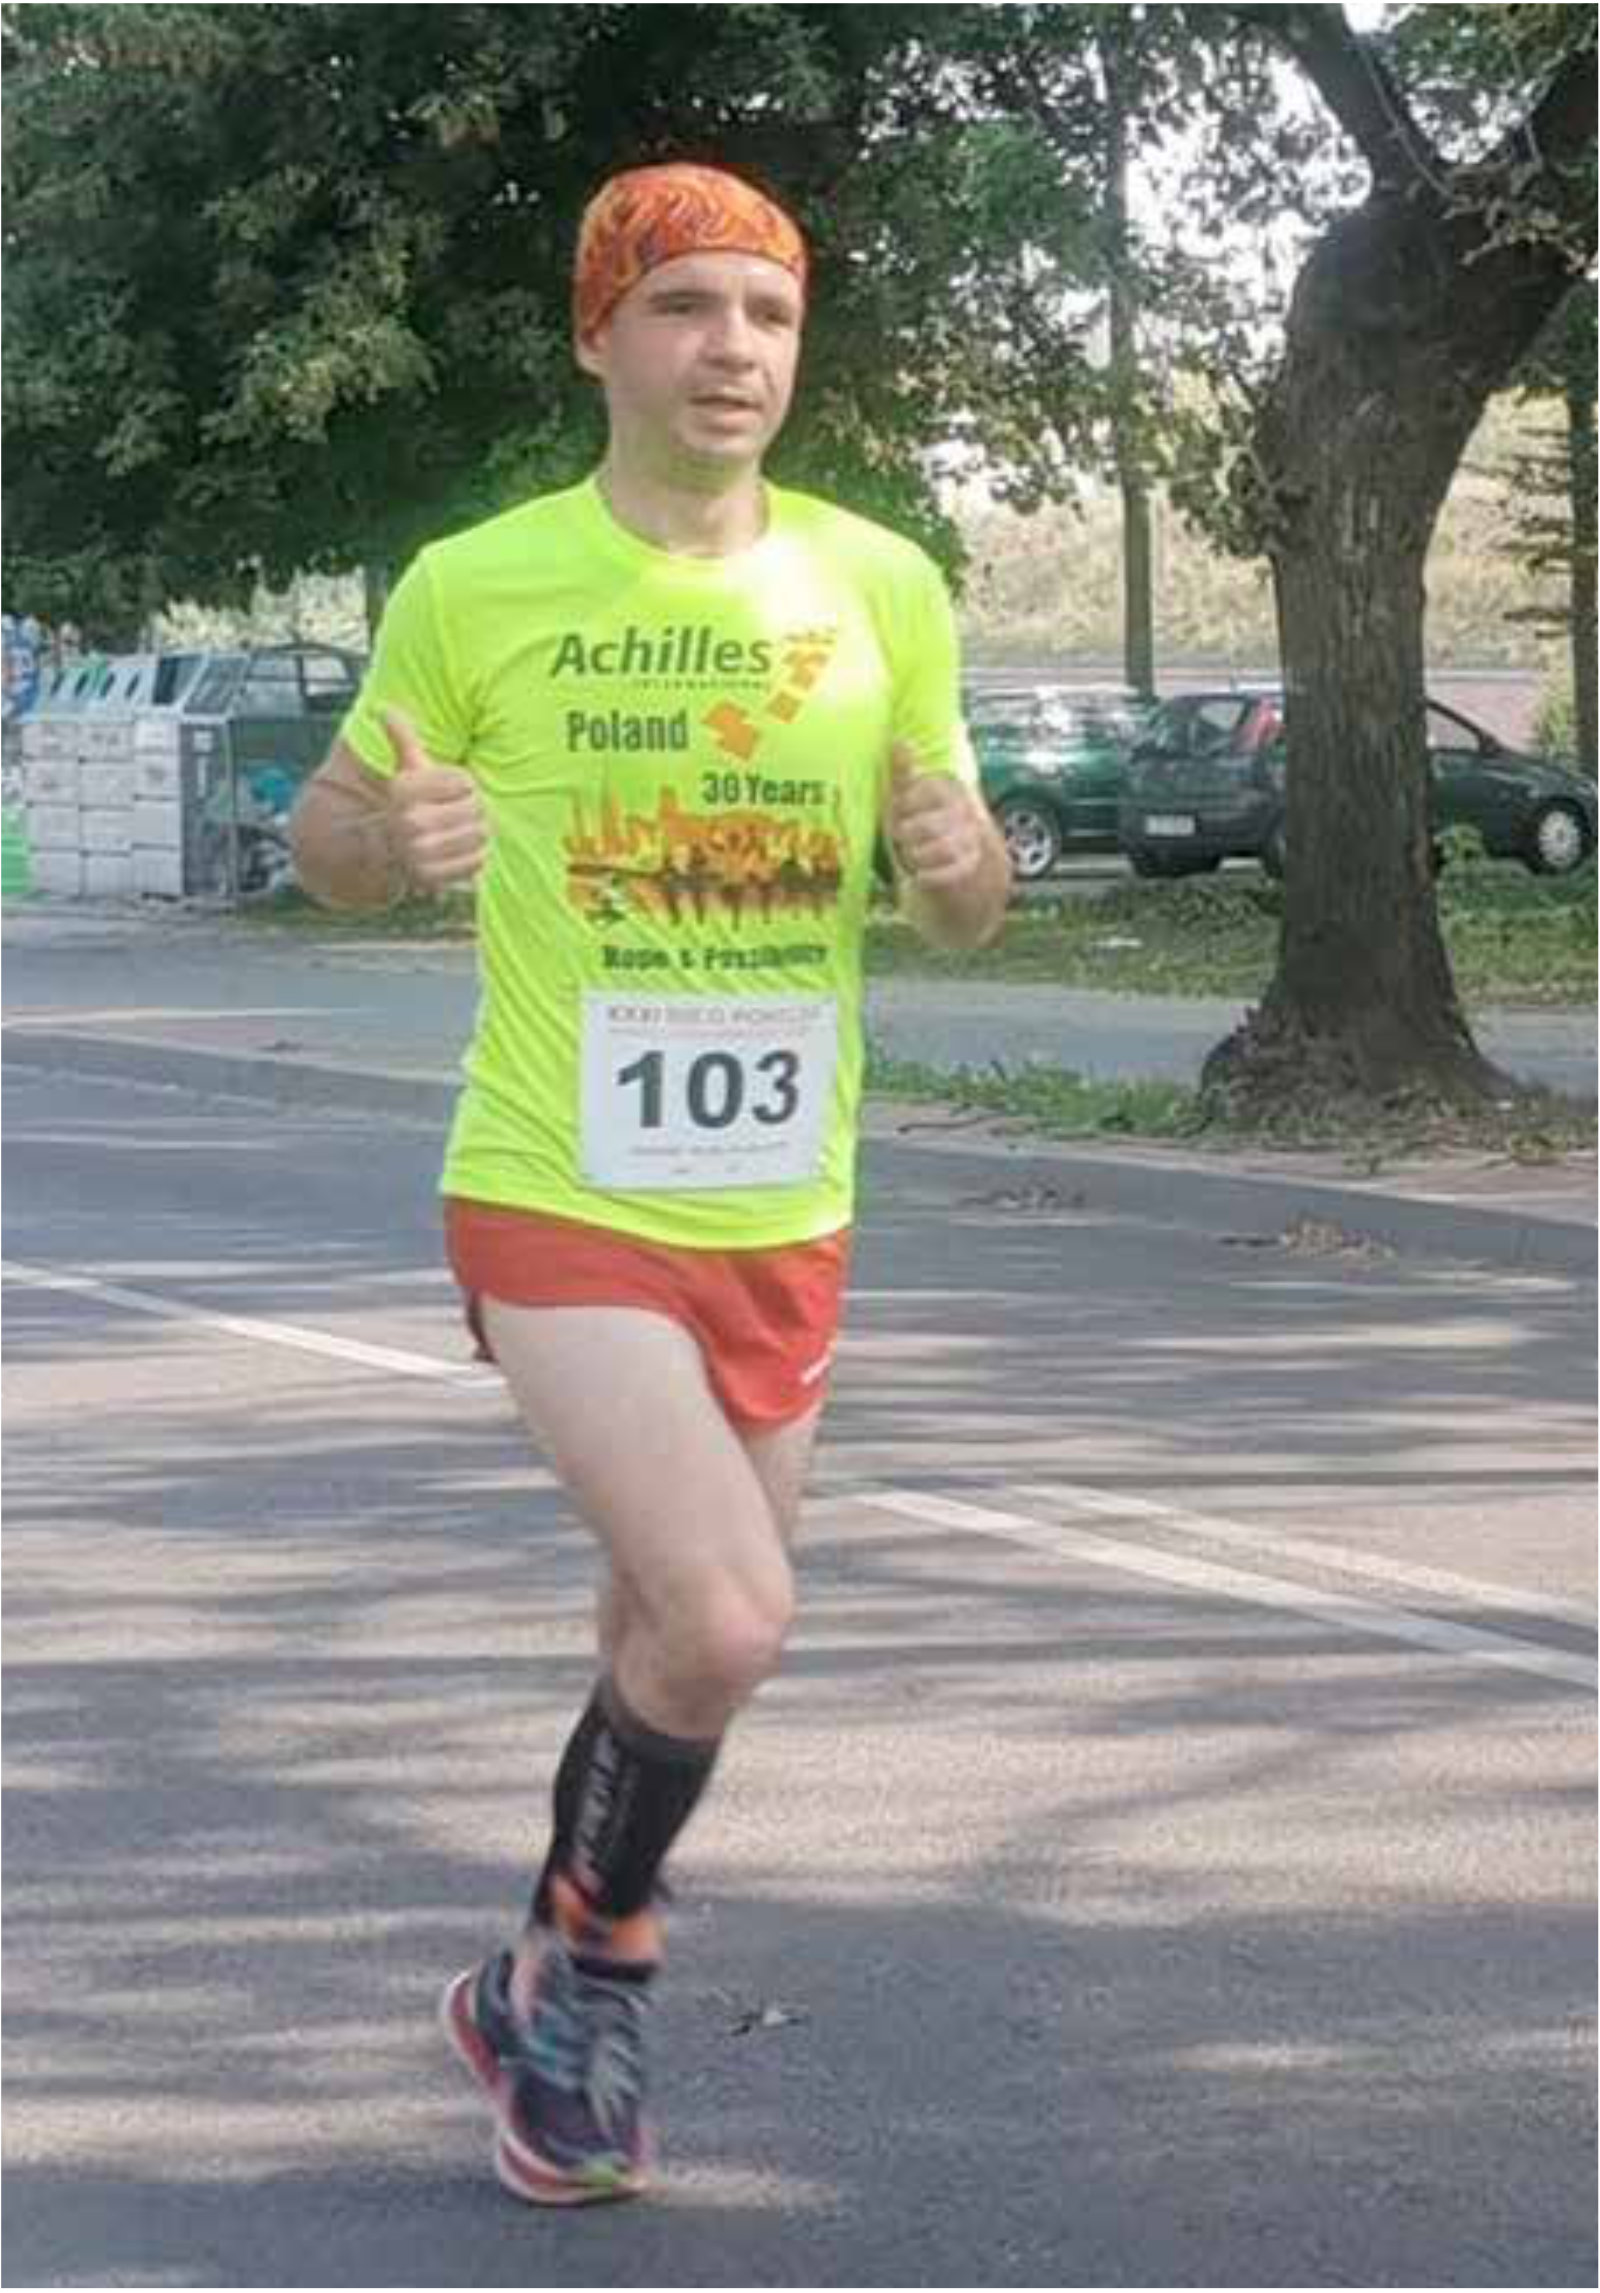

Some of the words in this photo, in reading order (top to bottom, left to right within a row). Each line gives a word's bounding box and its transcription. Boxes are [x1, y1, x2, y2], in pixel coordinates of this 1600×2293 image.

[549, 626, 772, 677] Achilles
[567, 710, 689, 751] Poland
[702, 771, 739, 804] 30
[745, 772, 827, 805] Years
[617, 1050, 800, 1128] 103
